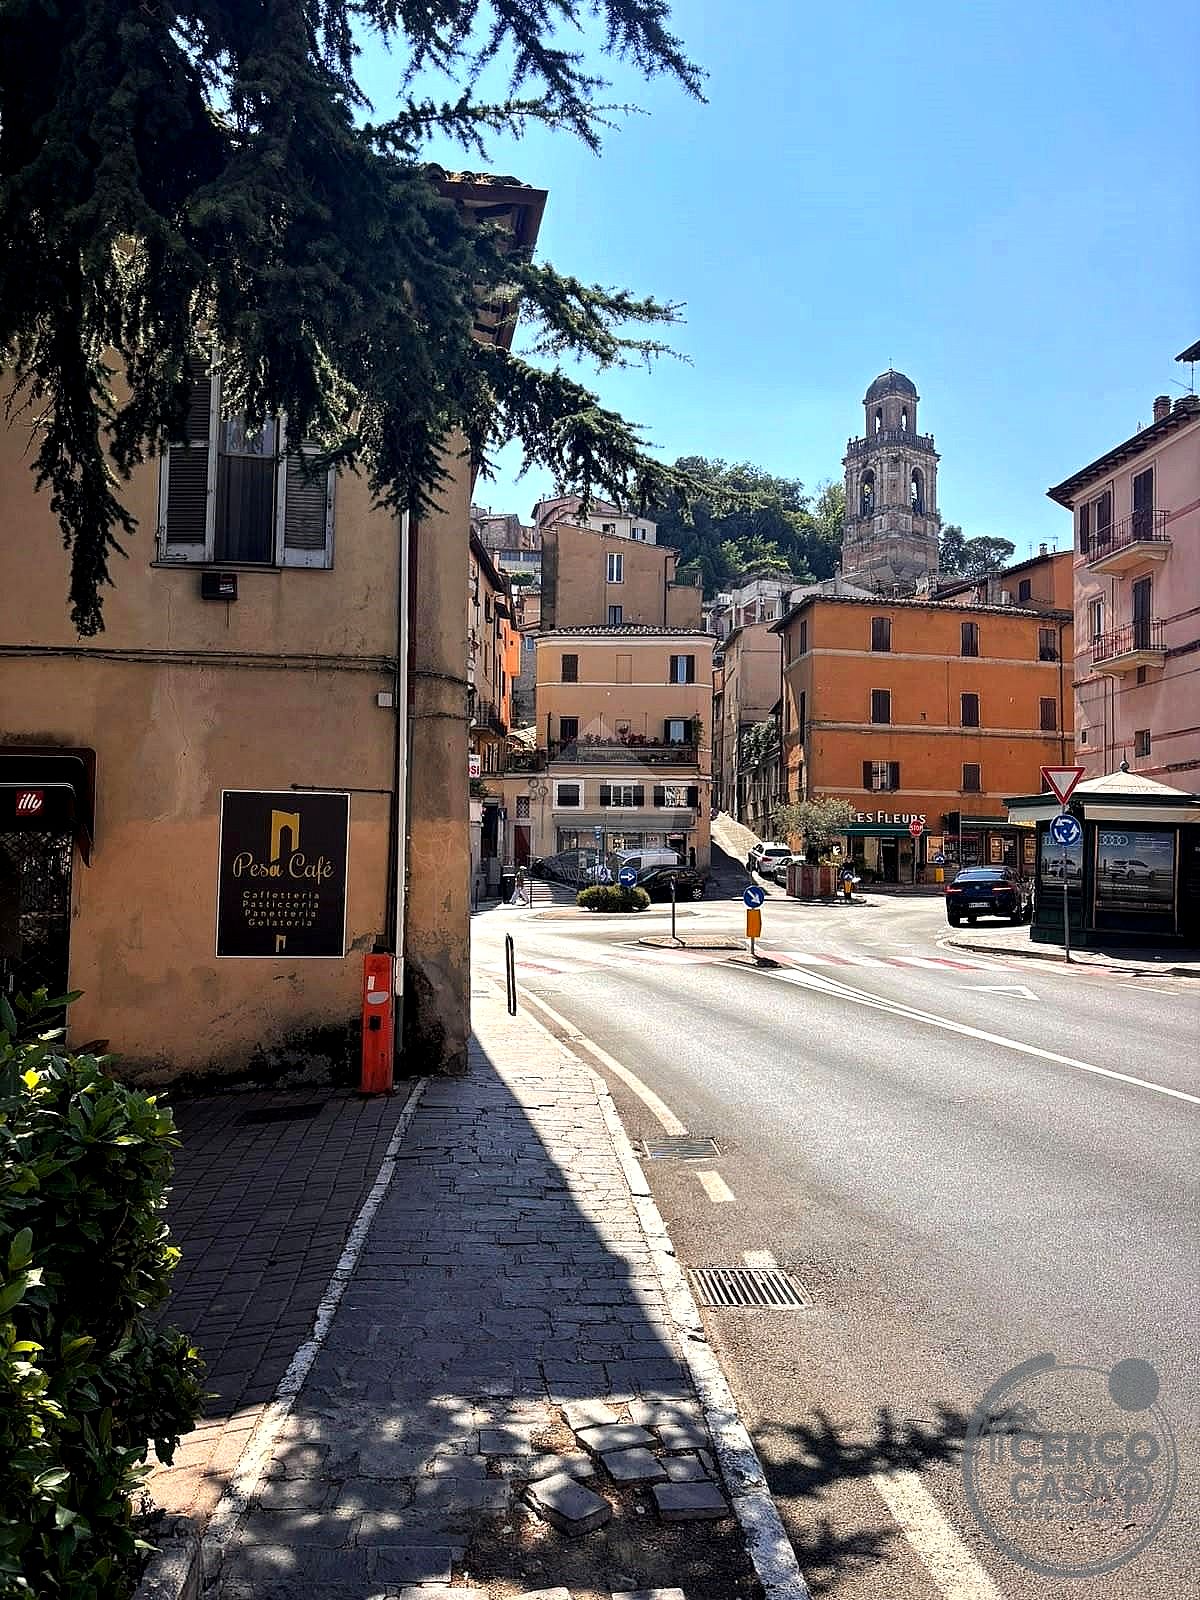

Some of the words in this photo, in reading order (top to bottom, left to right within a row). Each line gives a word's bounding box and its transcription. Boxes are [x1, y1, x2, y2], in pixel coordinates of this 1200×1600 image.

[17, 793, 42, 813] illy
[849, 812, 873, 823] LES
[877, 810, 927, 824] FLEURS
[233, 851, 284, 878] Pesa
[289, 852, 336, 885] Café
[242, 890, 320, 899] Caffetteria
[242, 900, 319, 909] Pasticceria
[244, 909, 316, 917] Panetteria
[248, 918, 313, 927] Gelateria
